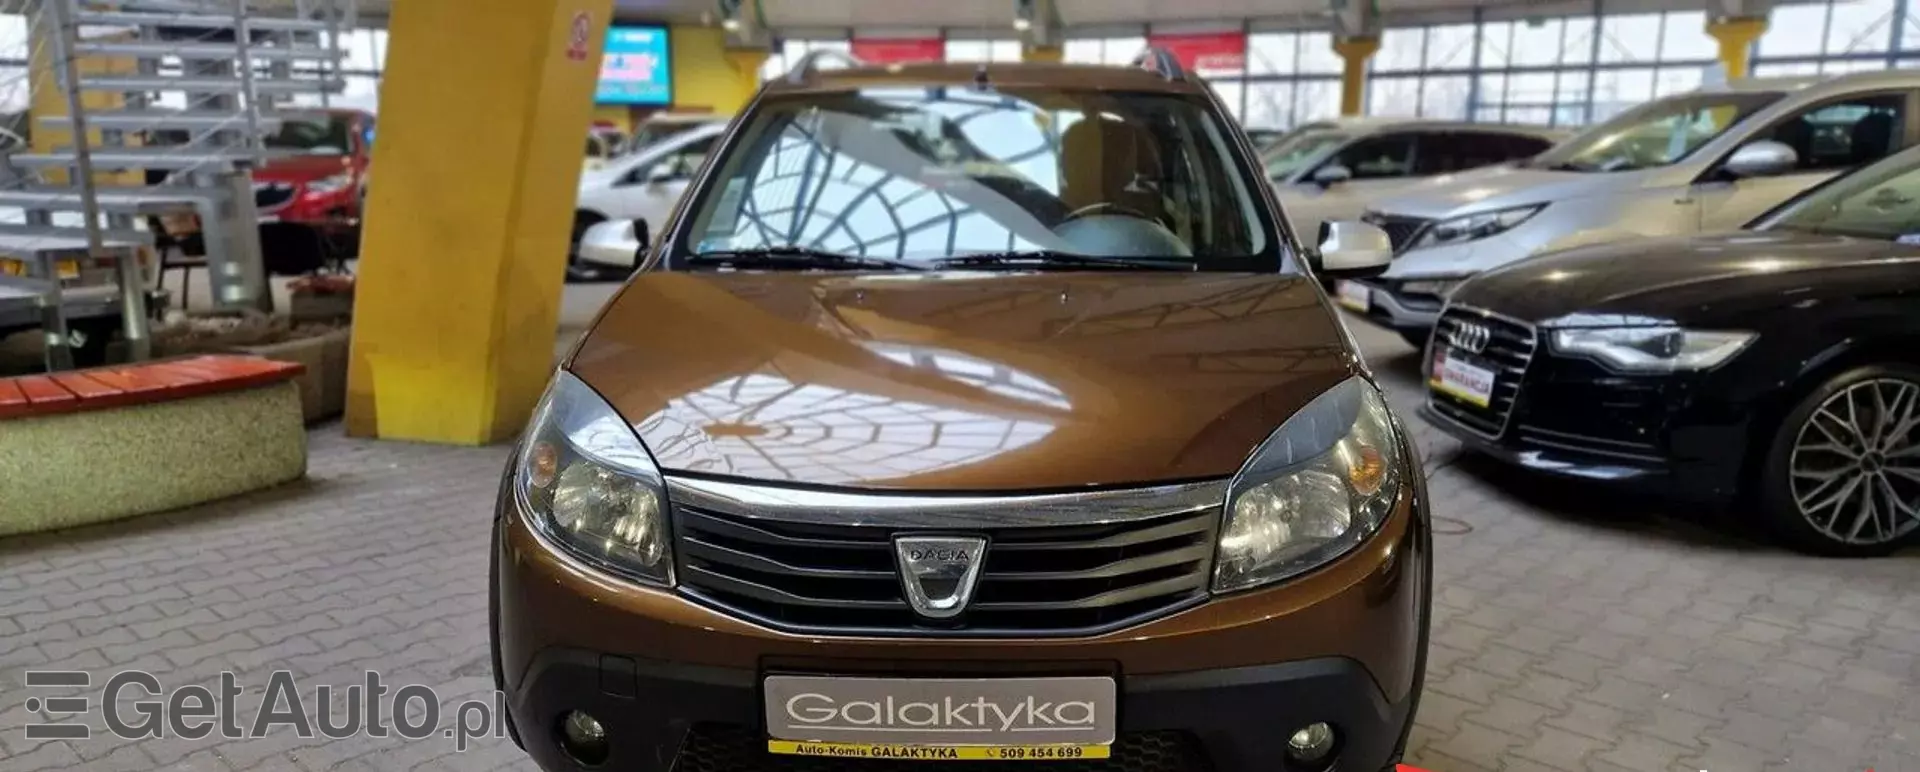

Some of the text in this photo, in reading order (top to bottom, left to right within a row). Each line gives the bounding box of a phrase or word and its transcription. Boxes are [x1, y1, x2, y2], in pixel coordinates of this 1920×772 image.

[910, 550, 969, 560] DACIA
[786, 693, 1095, 731] Galaktyka
[796, 744, 1082, 758] Auto-Komis GALAKTYKA 509 454 699
